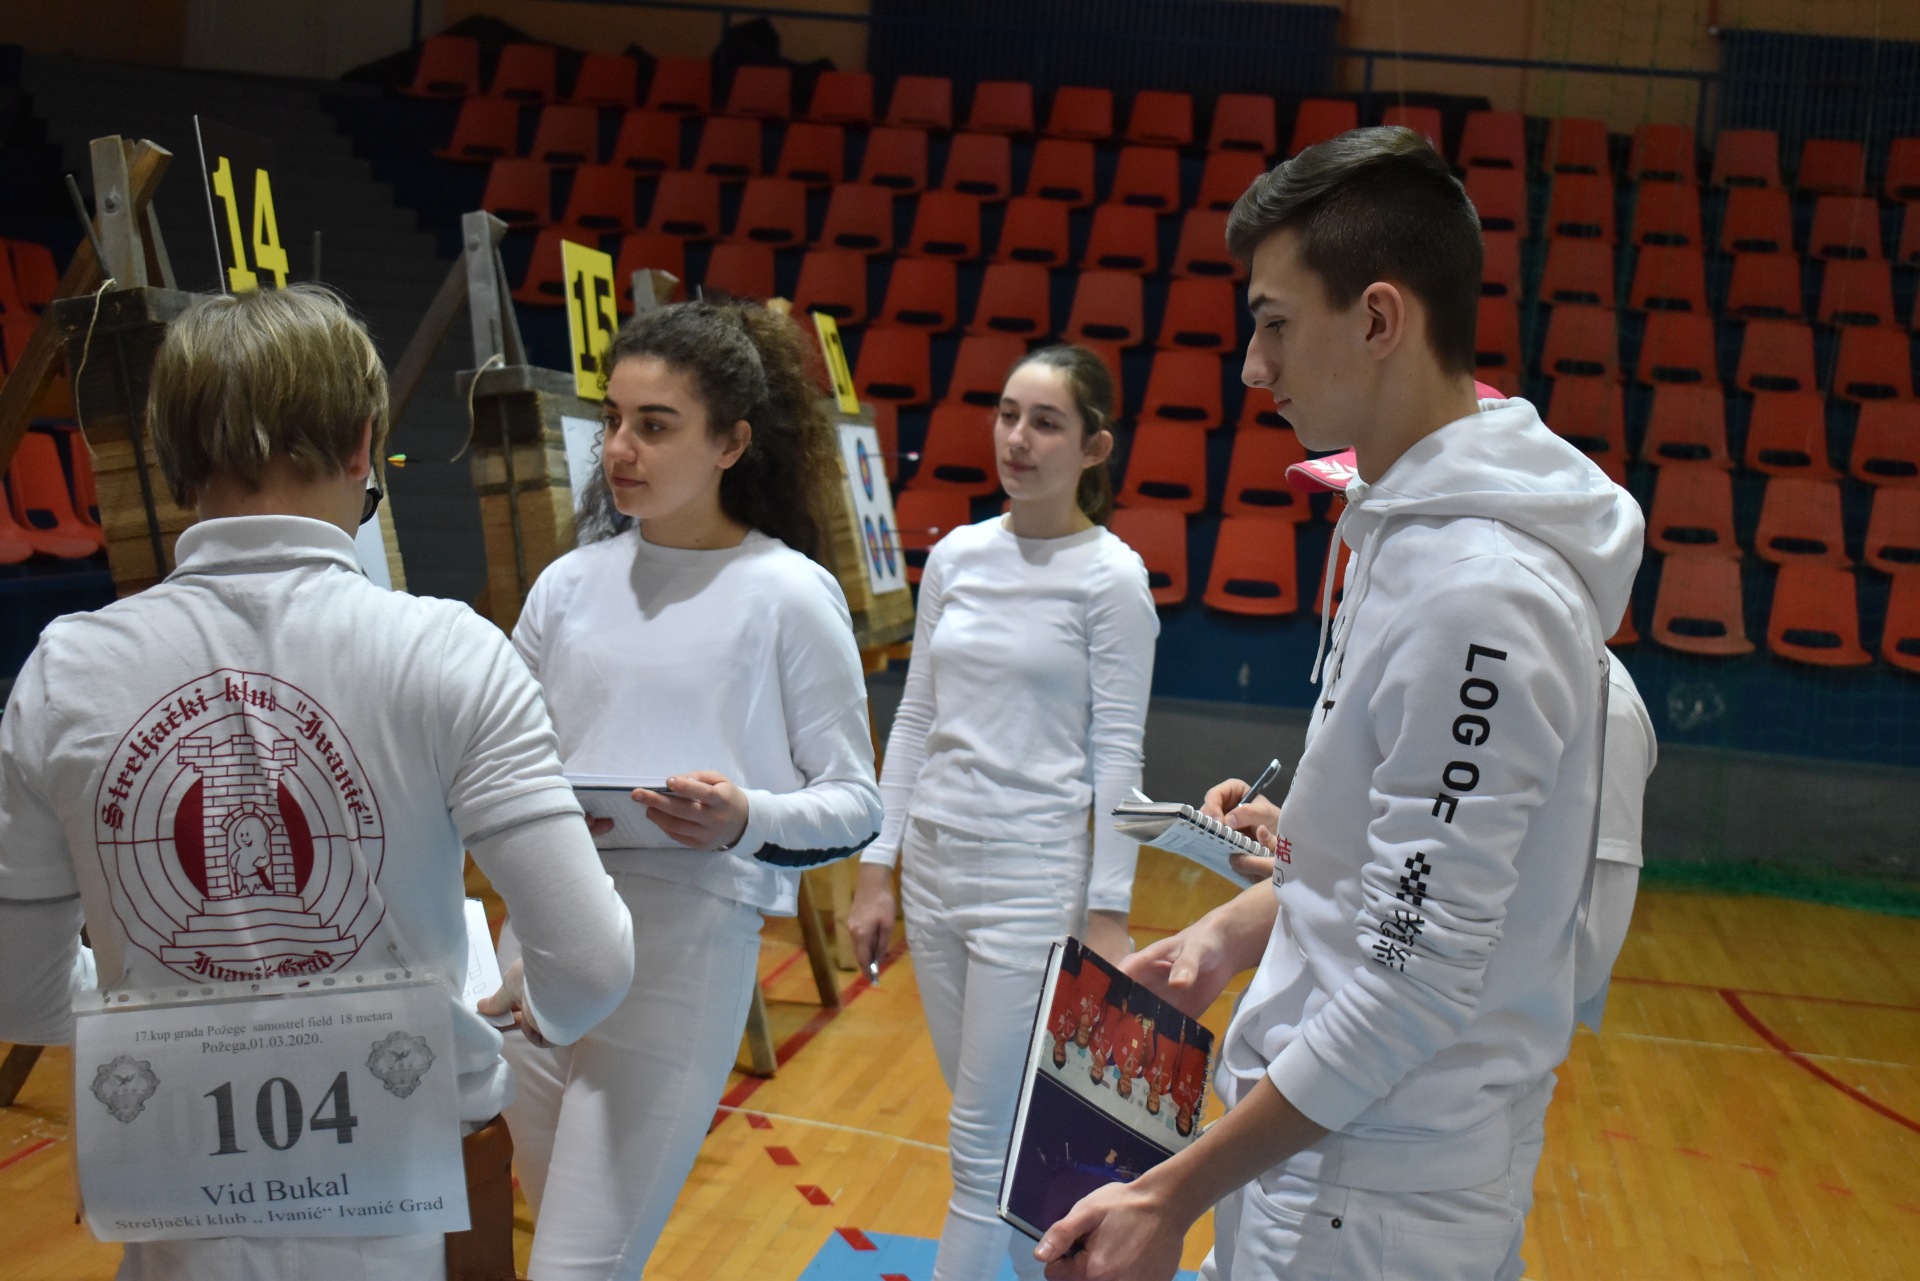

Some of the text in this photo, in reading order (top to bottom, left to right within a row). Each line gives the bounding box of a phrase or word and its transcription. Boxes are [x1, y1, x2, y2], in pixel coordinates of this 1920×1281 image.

[212, 155, 289, 293] 14
[573, 270, 616, 373] 15
[1452, 643, 1508, 747] LOG
[135, 1011, 393, 1042] 17.kup grada Požege samostrel field 18 metara
[202, 1032, 323, 1054] Požega,01.03.2020.
[203, 1071, 358, 1156] 104
[115, 1215, 201, 1231] Streljački
[207, 1212, 246, 1226] klub
[339, 1200, 394, 1218] Ivanić
[399, 1196, 444, 1213] Grad
[201, 1172, 350, 1206] Vid Bukal
